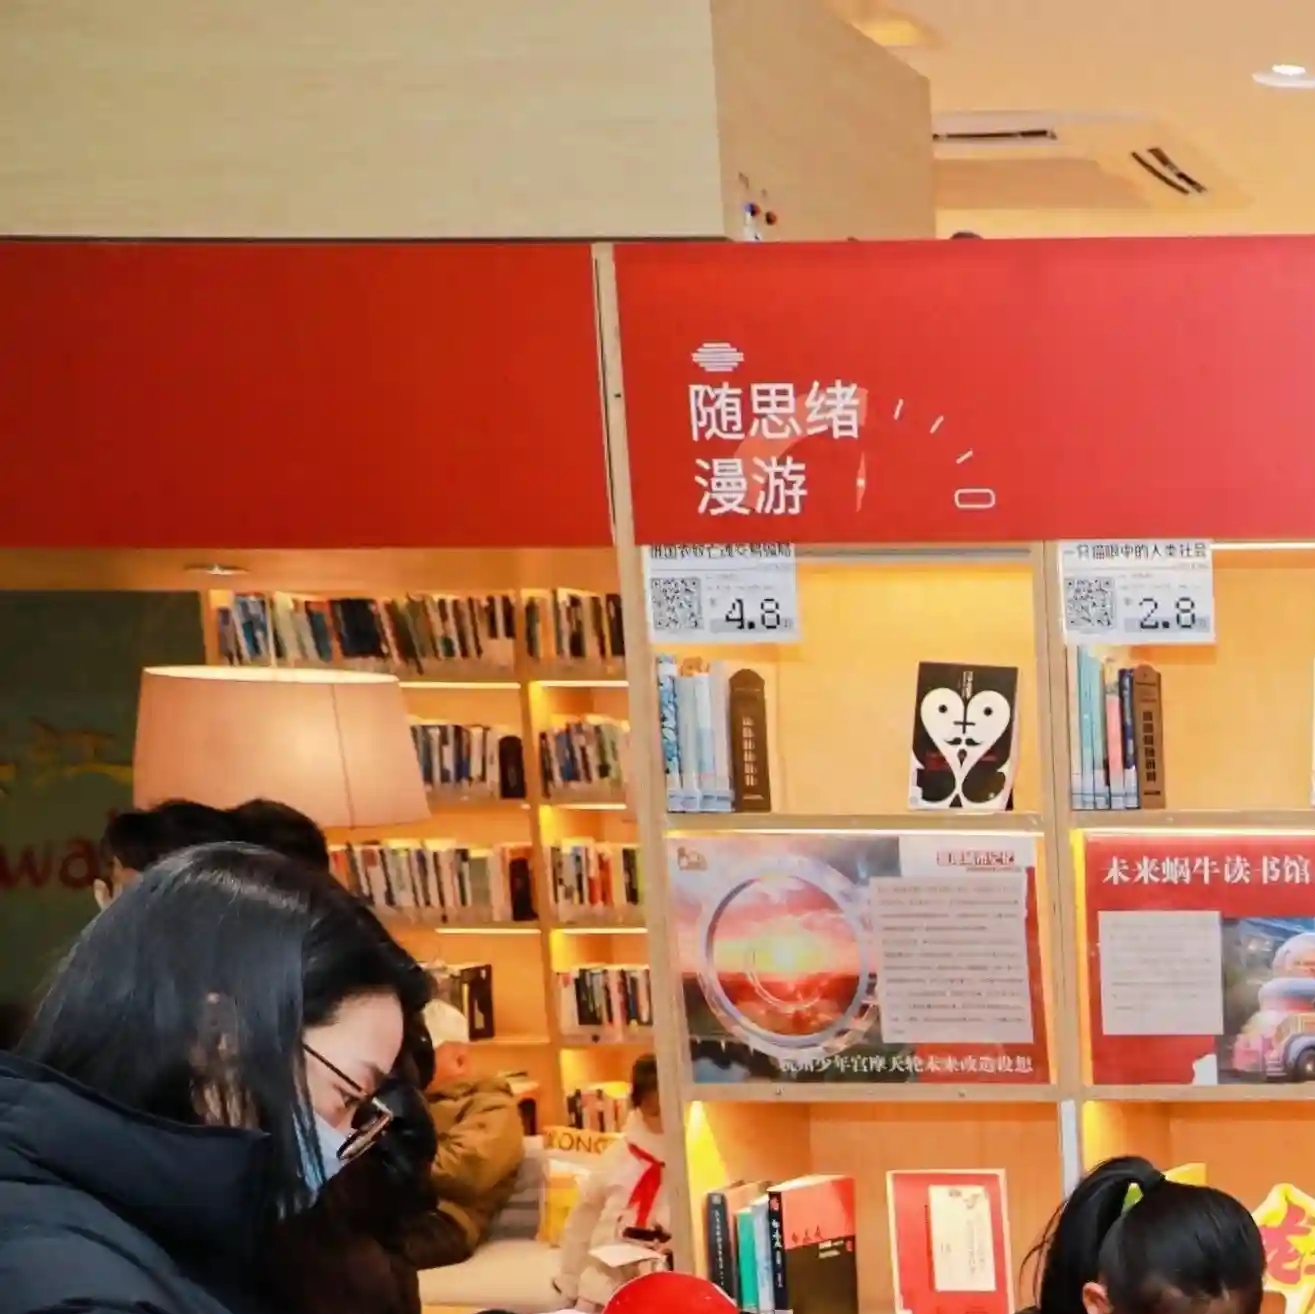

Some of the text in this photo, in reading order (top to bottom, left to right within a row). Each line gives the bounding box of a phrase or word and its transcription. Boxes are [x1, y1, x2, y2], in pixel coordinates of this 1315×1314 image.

[689, 380, 859, 441] 随思绪
[694, 457, 808, 515] 漫游
[725, 598, 781, 630] 4.8
[1139, 597, 1196, 629] 2.8
